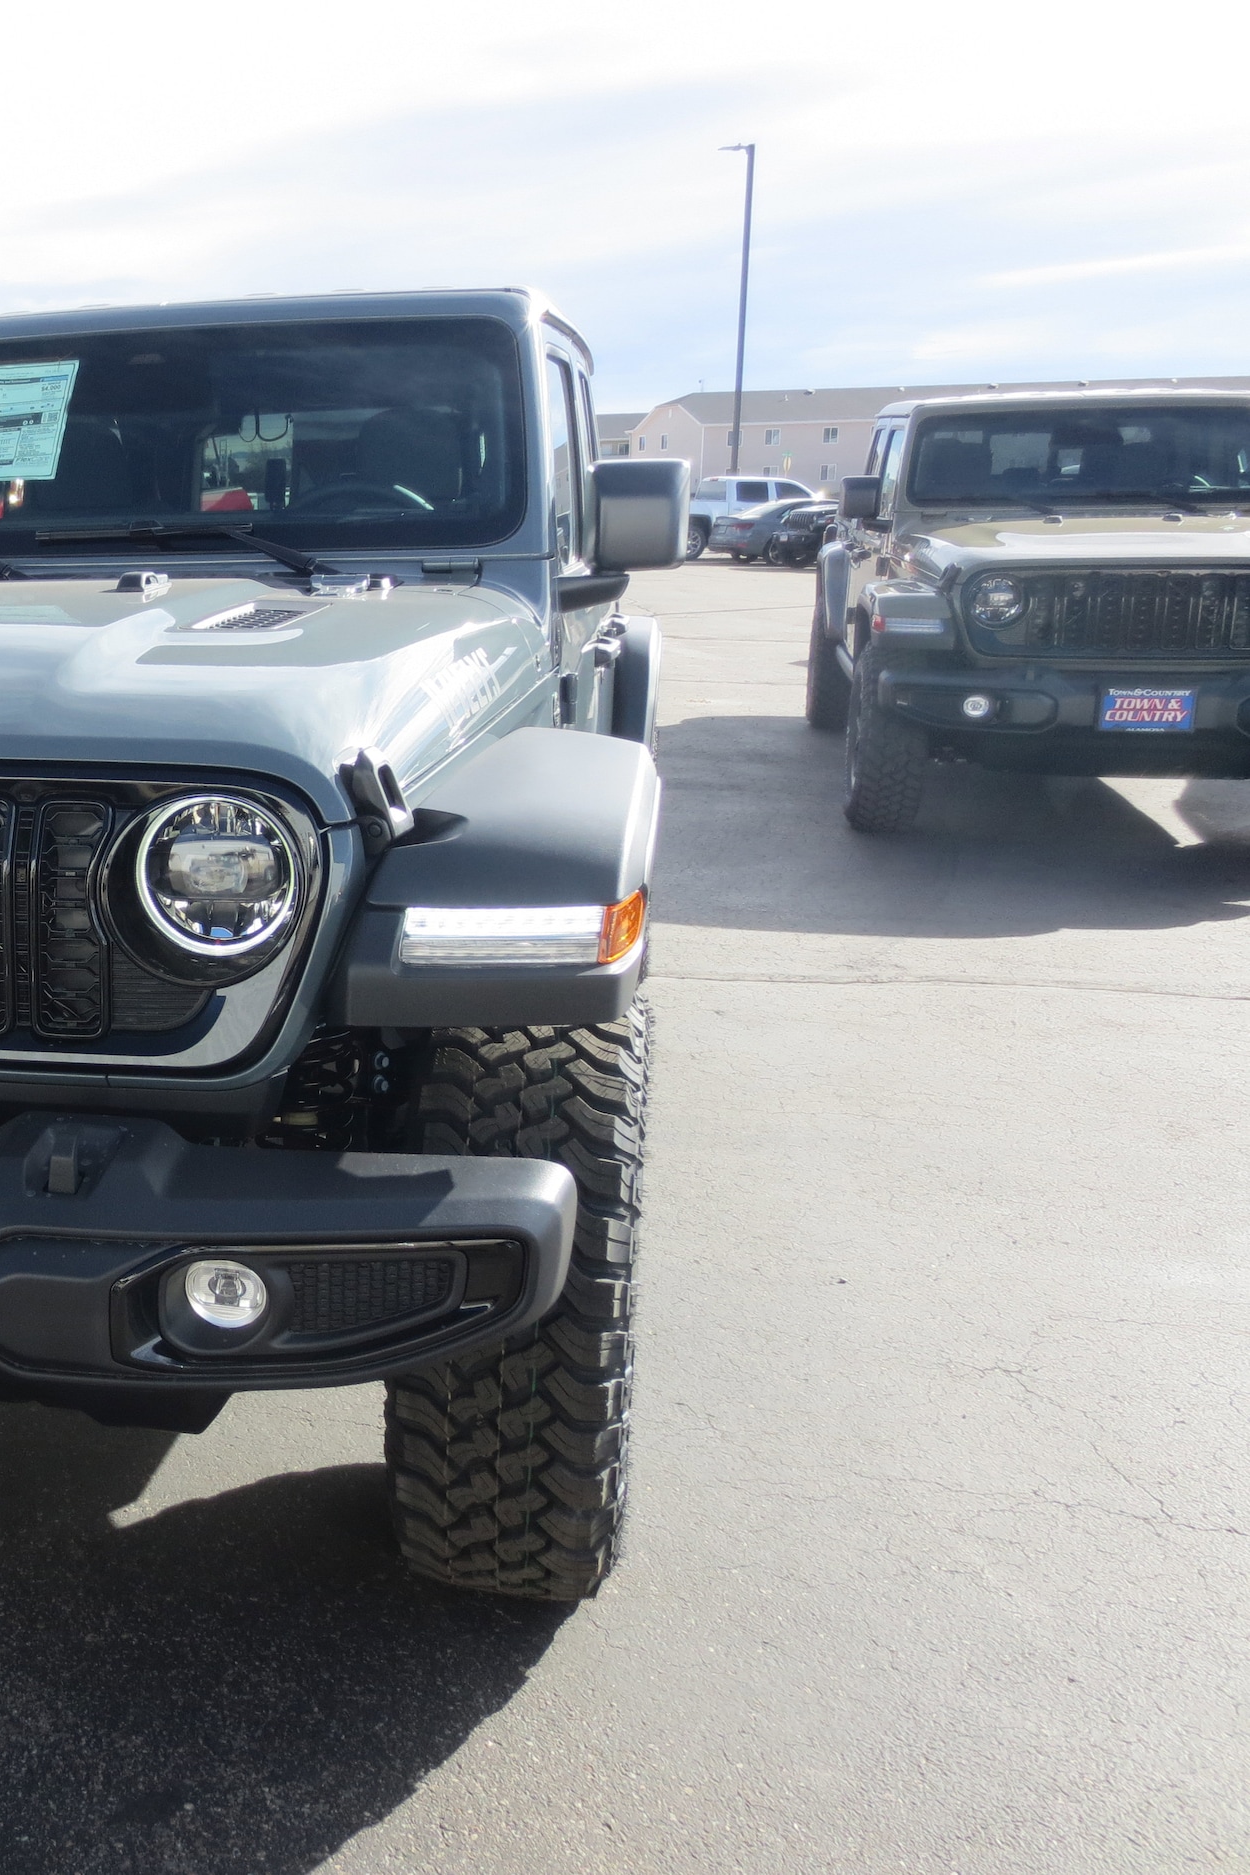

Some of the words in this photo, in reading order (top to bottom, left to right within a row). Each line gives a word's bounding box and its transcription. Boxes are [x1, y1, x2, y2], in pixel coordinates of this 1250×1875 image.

[1114, 697, 1166, 710] TOWN
[1167, 698, 1182, 710] &
[1104, 709, 1188, 722] COUNTRY
